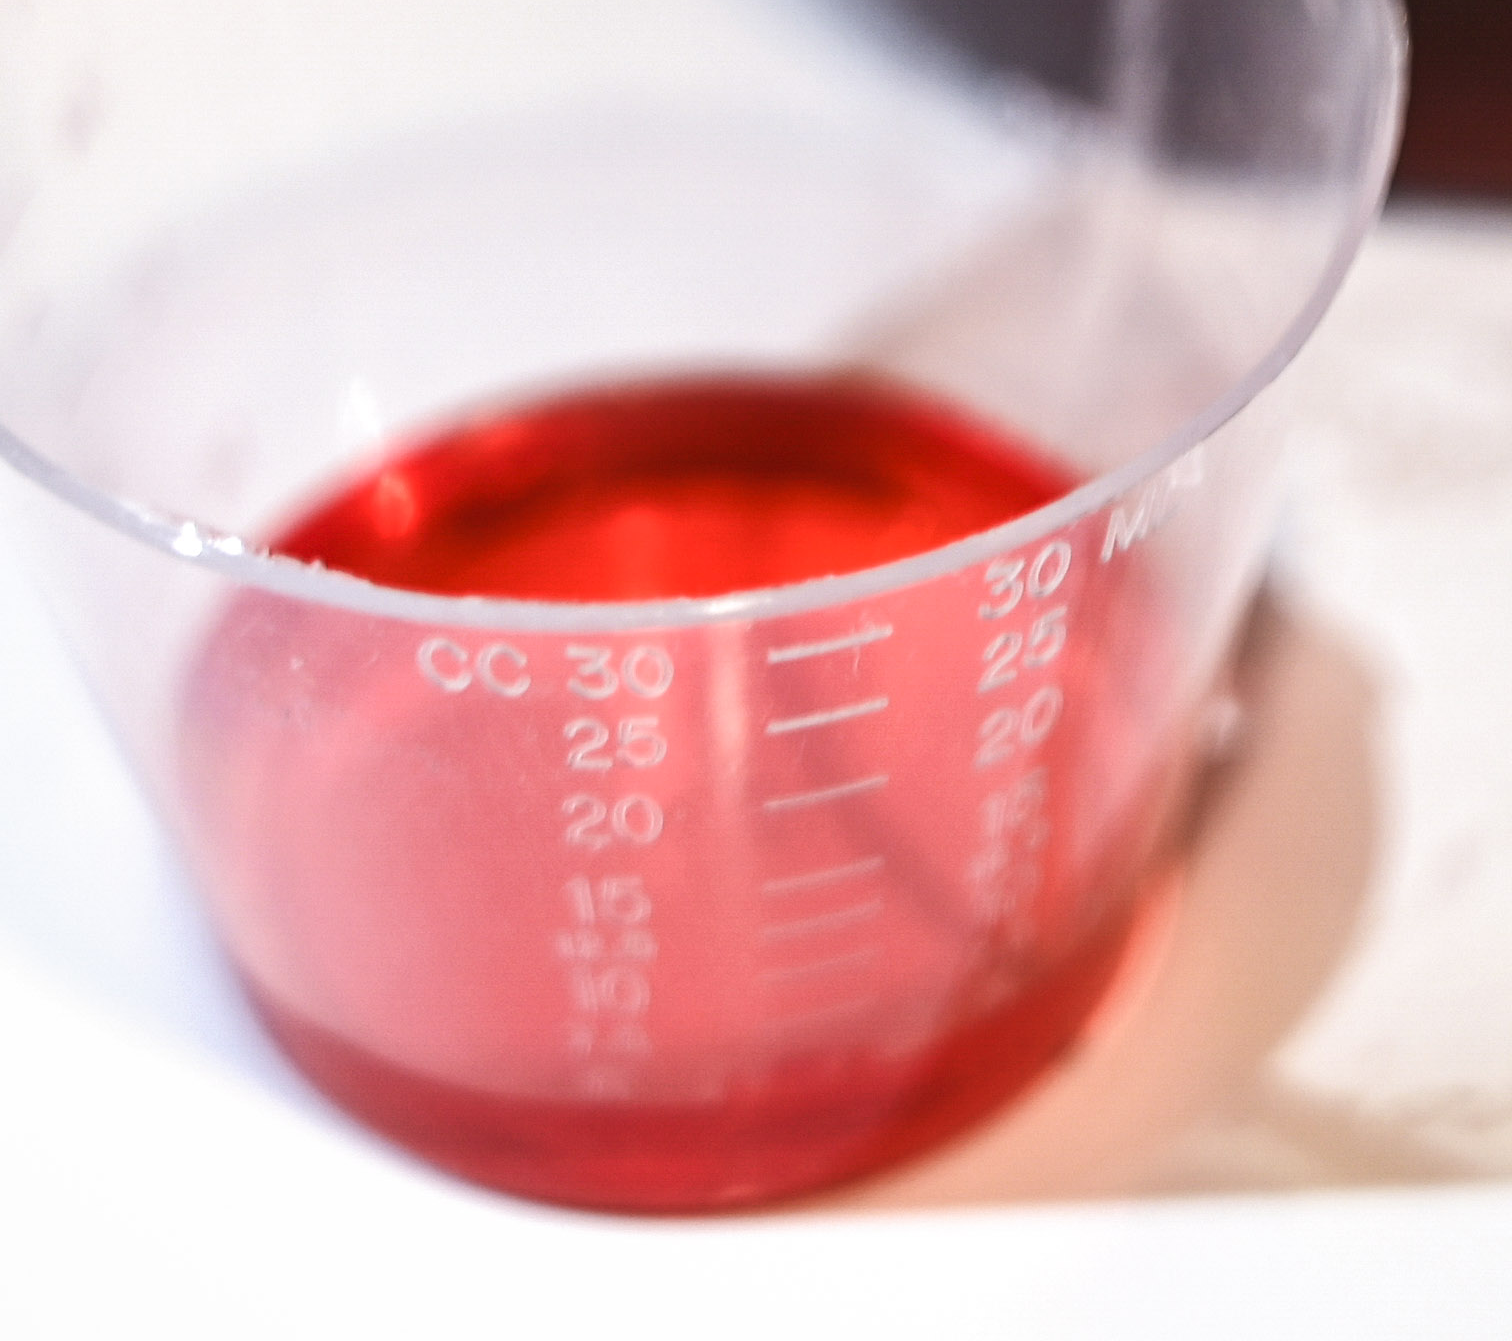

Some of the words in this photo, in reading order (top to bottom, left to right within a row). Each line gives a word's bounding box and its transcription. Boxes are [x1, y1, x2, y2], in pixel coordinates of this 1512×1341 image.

[978, 540, 1072, 620] 30
[417, 636, 531, 699] CC
[564, 643, 675, 701] 30
[976, 604, 1068, 695] 25
[562, 717, 669, 773] 25
[973, 685, 1065, 769] 20
[559, 794, 665, 851] 20
